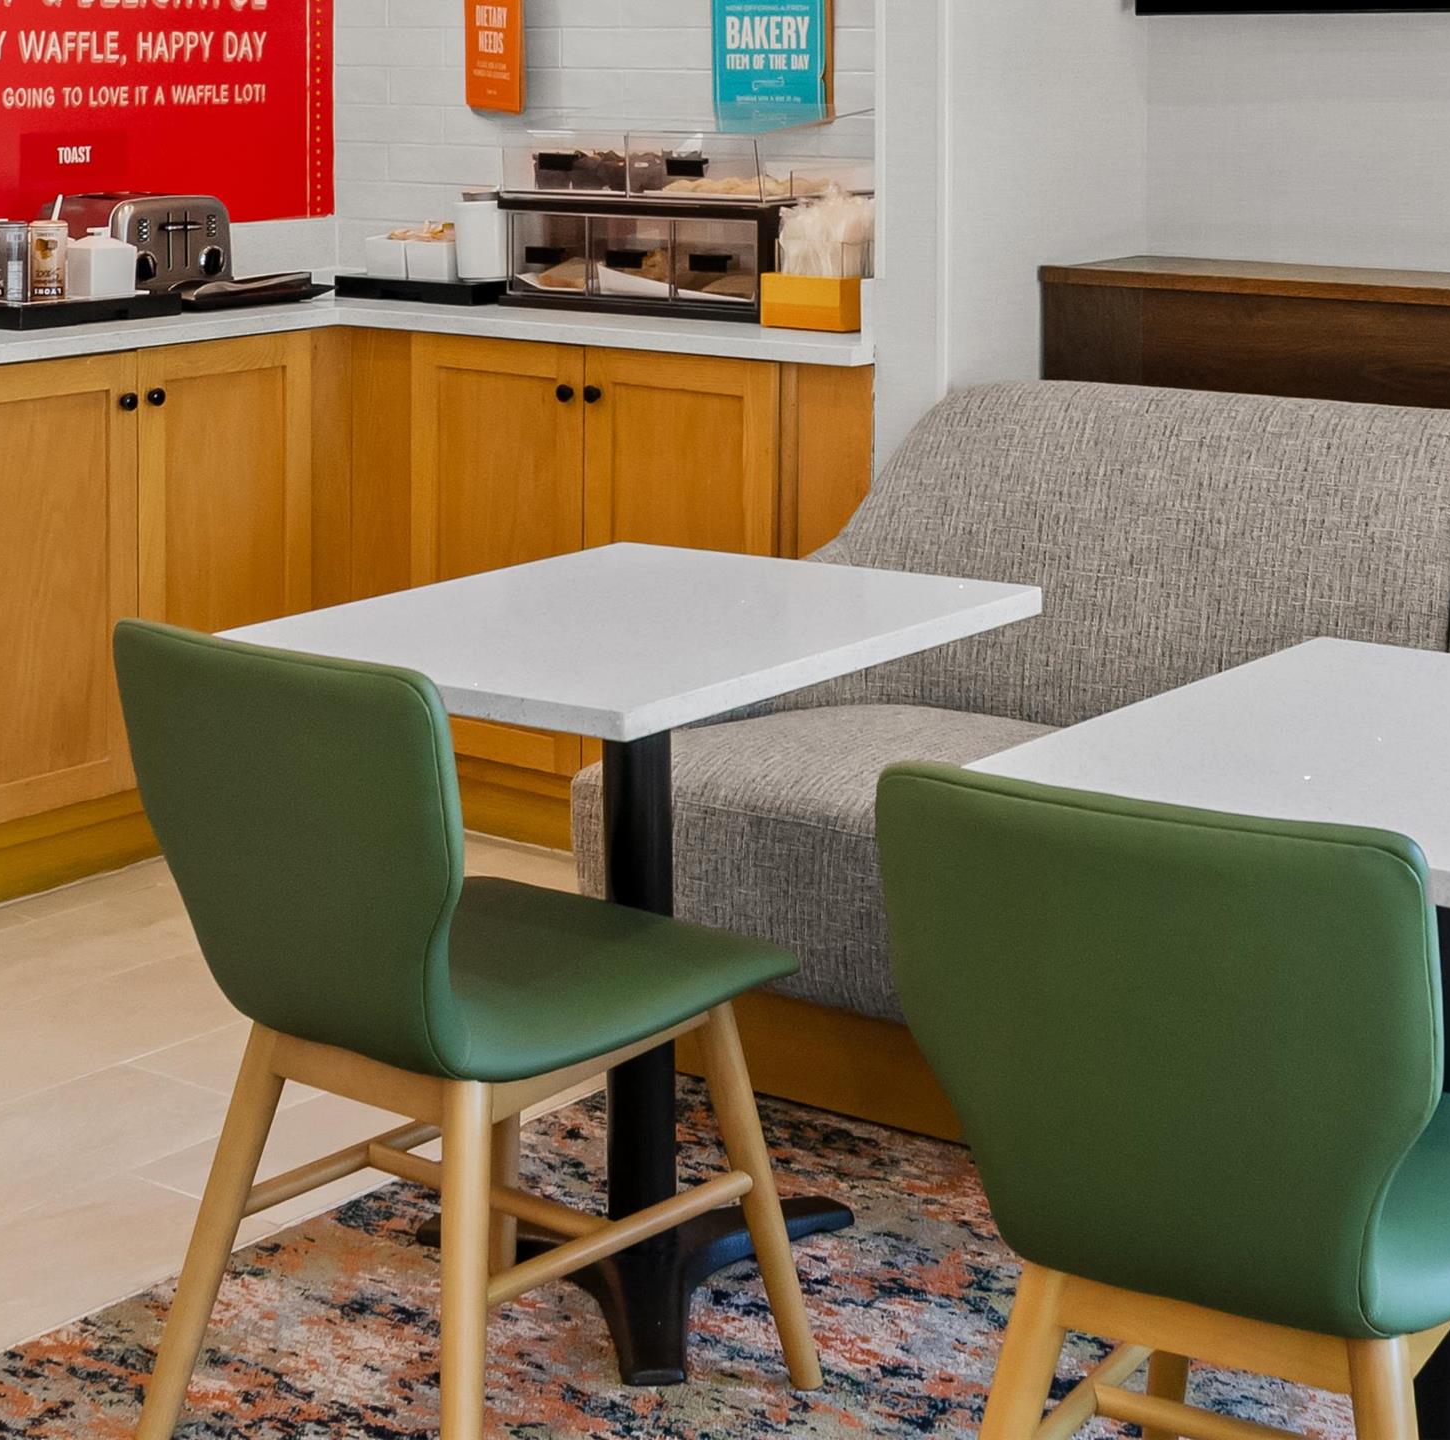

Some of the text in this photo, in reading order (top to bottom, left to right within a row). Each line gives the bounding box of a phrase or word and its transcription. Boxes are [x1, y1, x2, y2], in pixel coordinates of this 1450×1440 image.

[475, 4, 508, 29] DIETARY
[478, 30, 504, 54] NEEDS
[725, 15, 810, 50] BAKERY
[18, 30, 127, 67] WAFFLE,
[137, 31, 214, 63] HAPPY
[223, 31, 267, 63] DAY
[726, 54, 810, 70] ITEM OF THE DAY
[2, 87, 55, 109] GOING
[62, 86, 83, 108] TO
[88, 86, 128, 107] LOVE
[135, 85, 148, 106] IT
[154, 85, 165, 106] A
[171, 84, 229, 105] WAFFLE
[234, 84, 266, 105] LOT!
[57, 146, 92, 164] TOAST
[34, 288, 62, 296] LYONS
